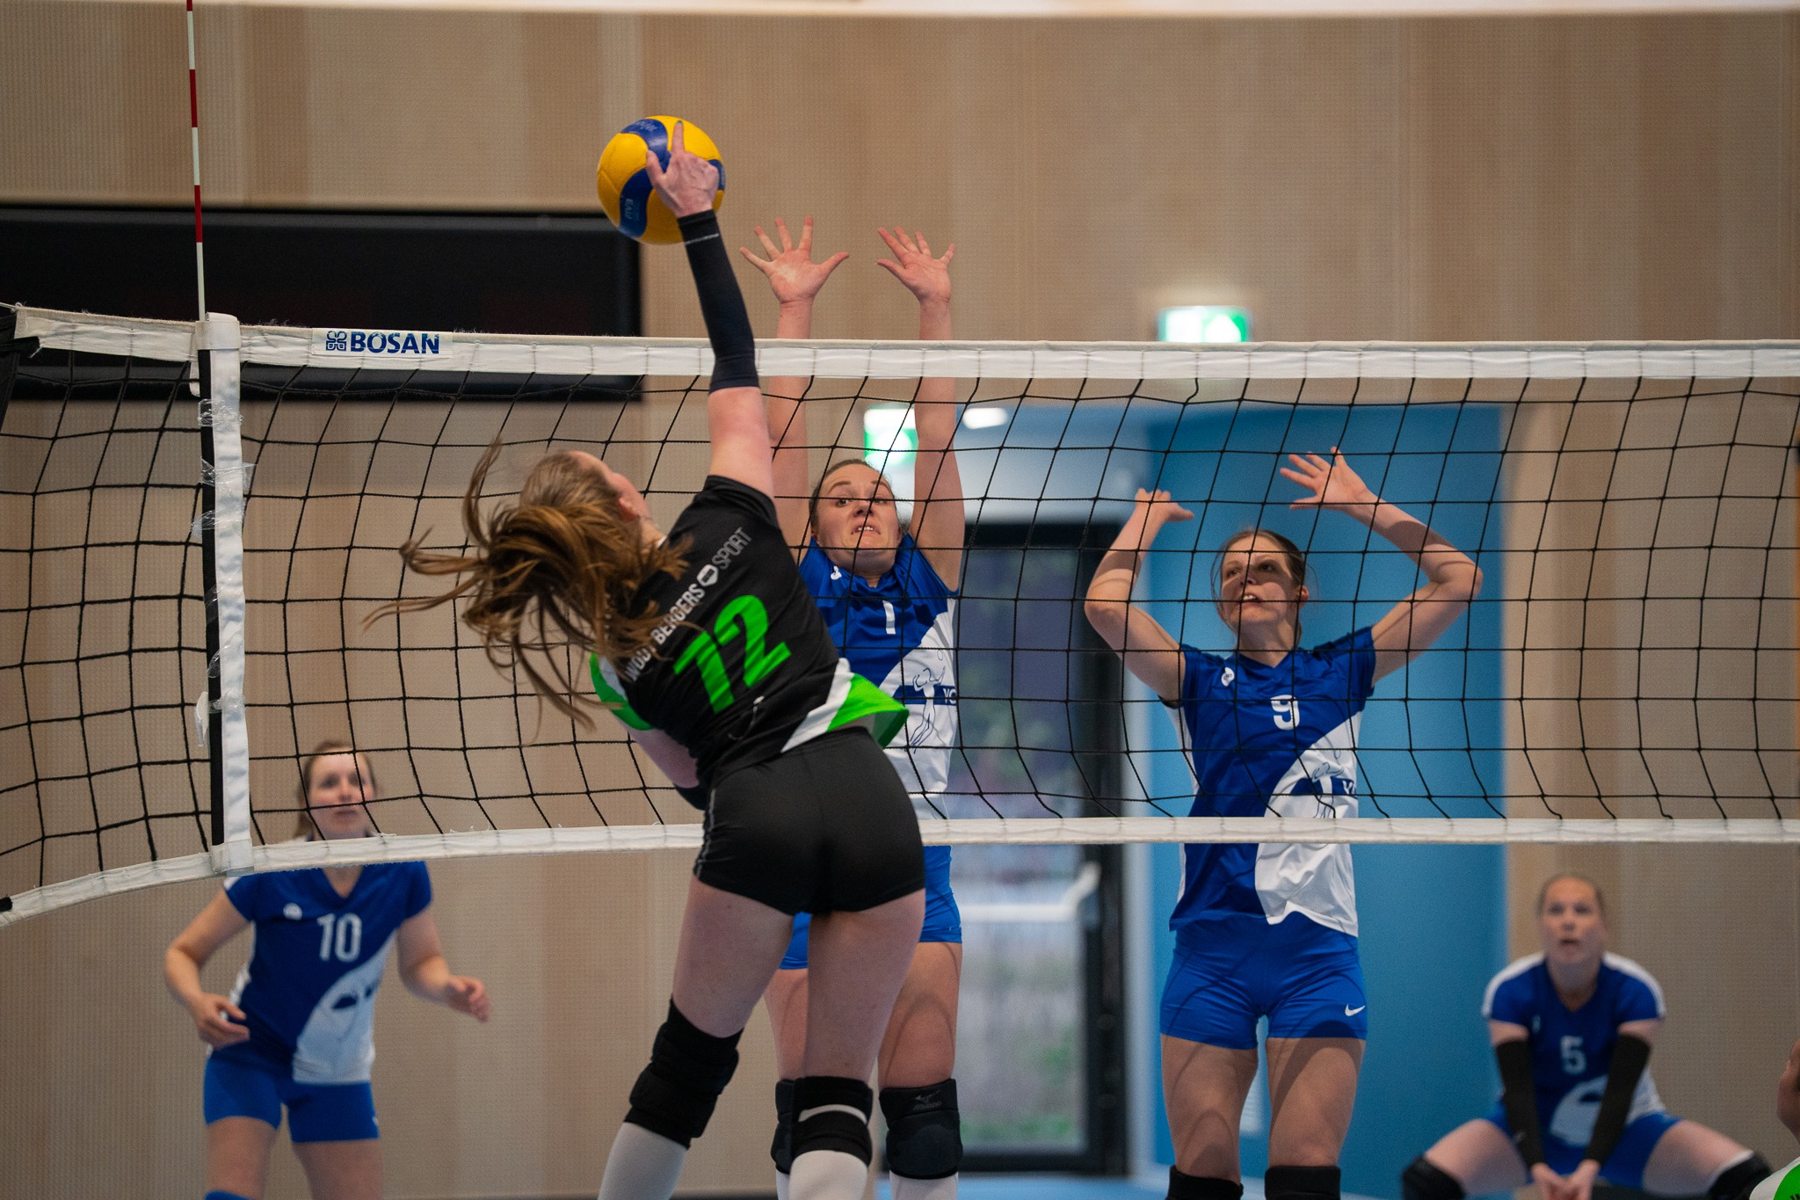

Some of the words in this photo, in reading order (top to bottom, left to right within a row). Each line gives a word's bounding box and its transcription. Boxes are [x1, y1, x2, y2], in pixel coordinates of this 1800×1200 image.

[350, 331, 440, 354] BOSAN
[650, 583, 705, 645] BERGERS
[712, 526, 752, 569] SPORT
[882, 600, 896, 635] 1
[1270, 694, 1300, 730] 9
[316, 912, 362, 962] 10
[1560, 1035, 1587, 1075] 5
